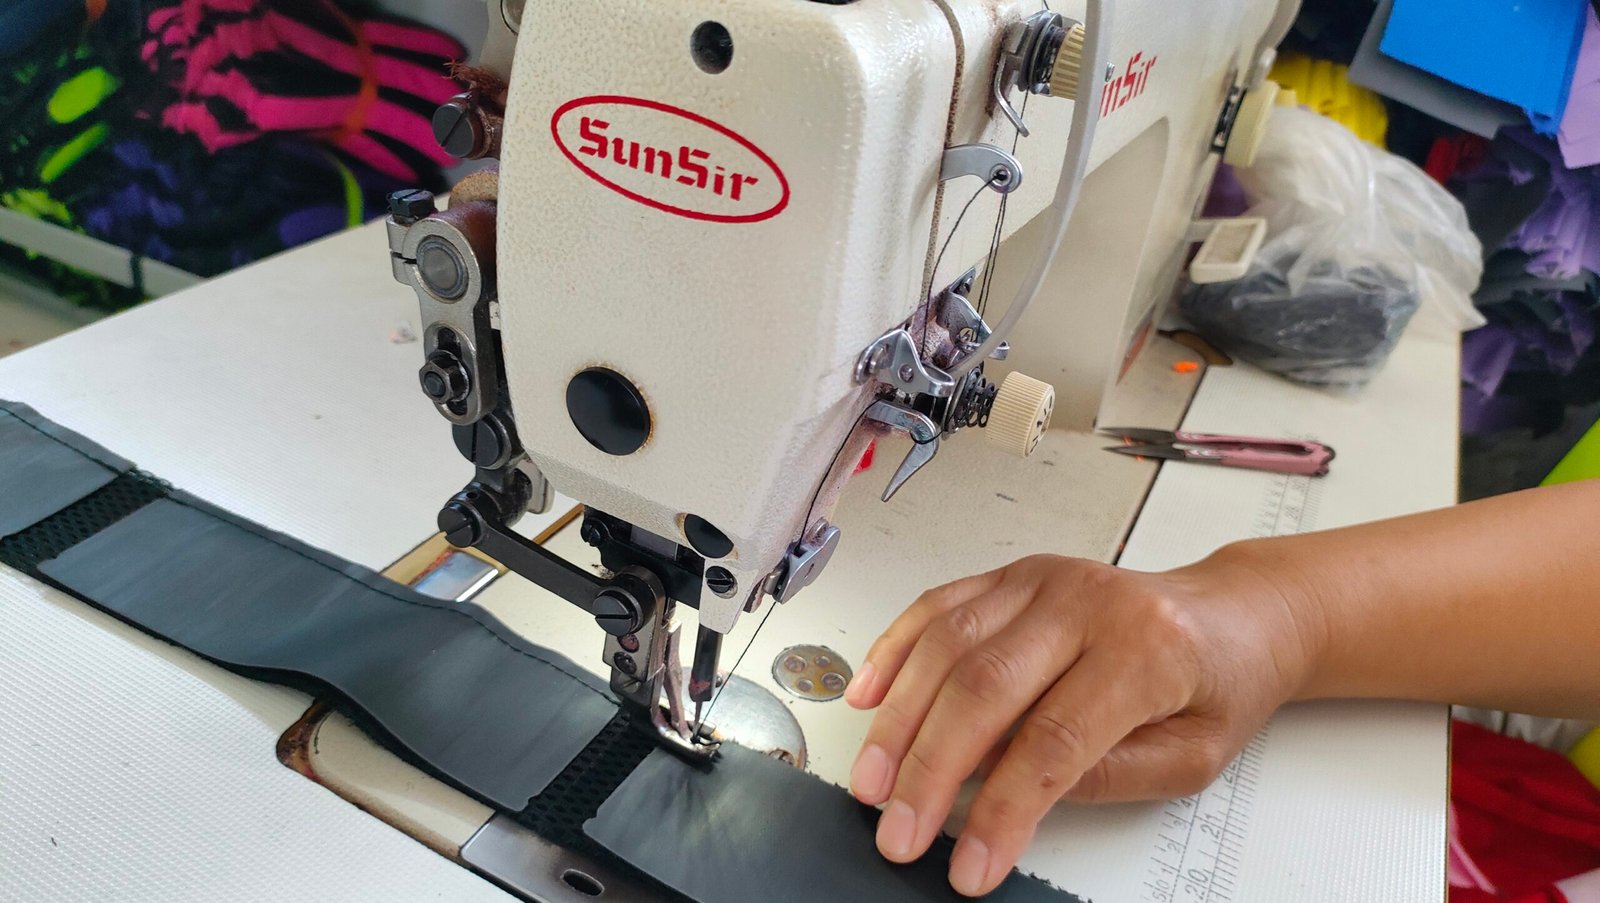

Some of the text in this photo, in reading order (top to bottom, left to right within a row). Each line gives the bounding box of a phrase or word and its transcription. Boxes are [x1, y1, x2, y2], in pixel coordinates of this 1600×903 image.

[578, 116, 759, 201] SunSir
[1184, 868, 1209, 900] 20
[1200, 812, 1223, 840] 21
